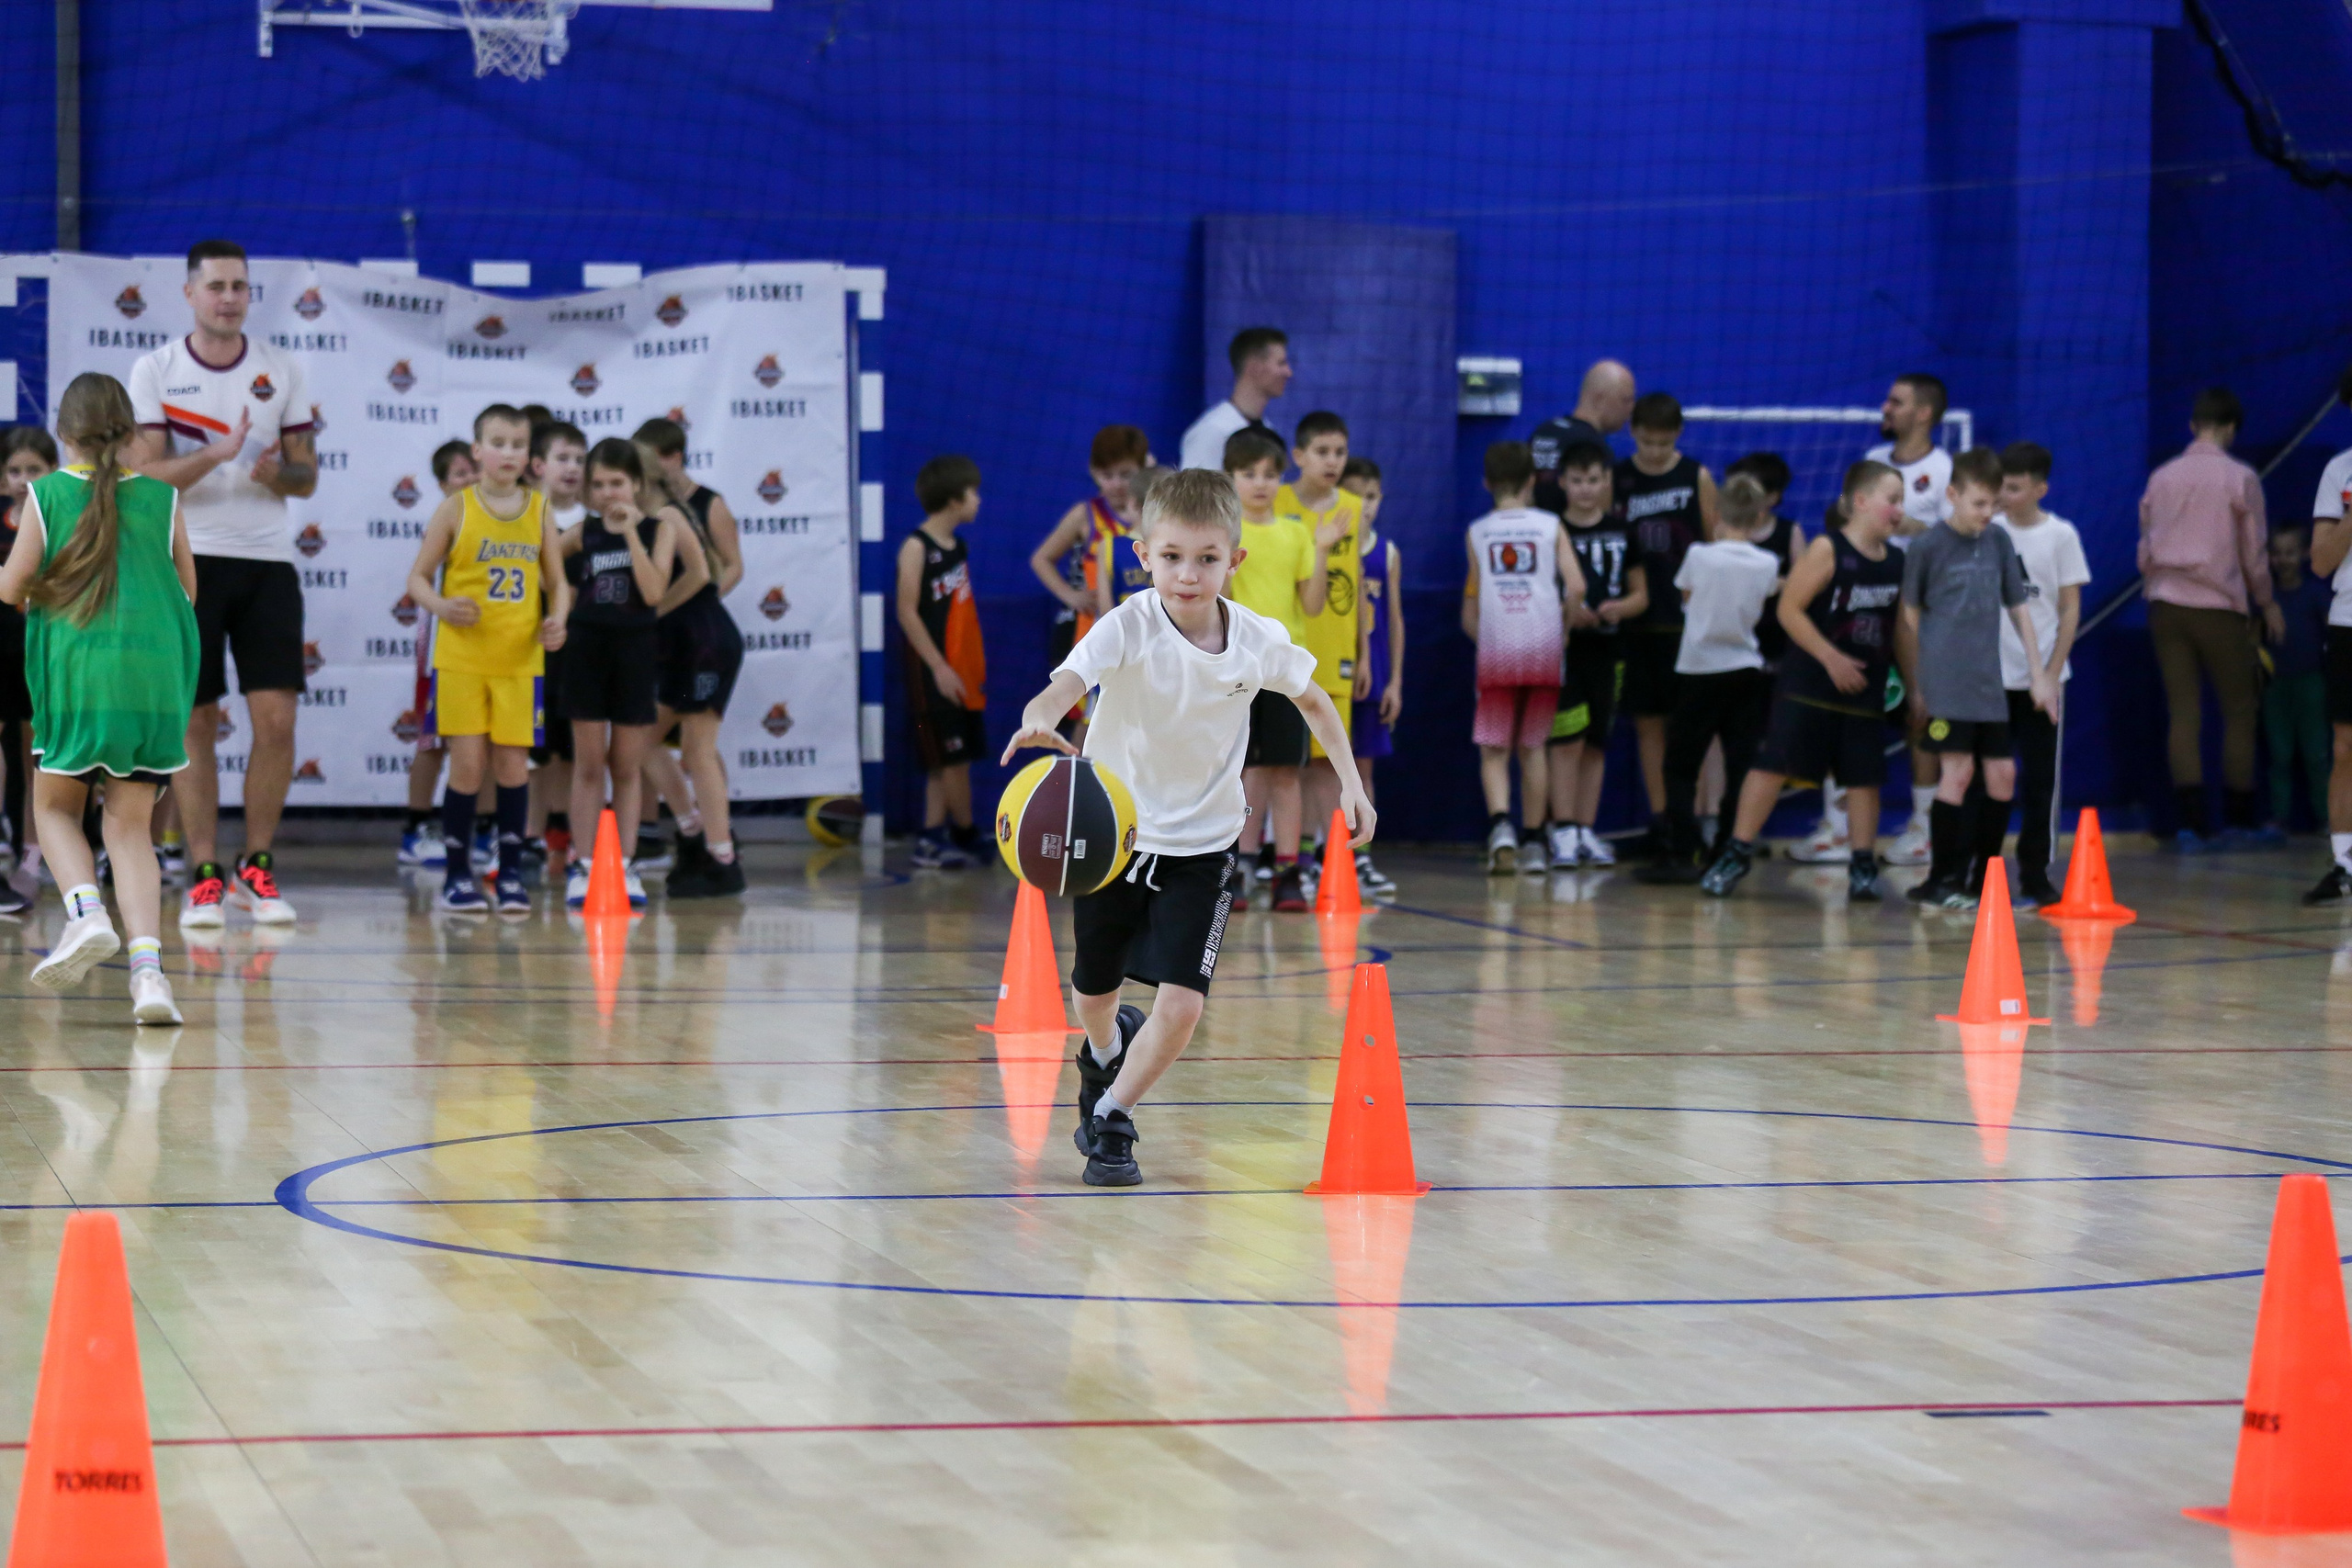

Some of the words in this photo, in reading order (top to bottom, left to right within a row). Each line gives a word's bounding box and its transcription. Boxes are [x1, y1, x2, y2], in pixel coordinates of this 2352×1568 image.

[552, 407, 623, 425] BASKET
[368, 521, 424, 539] IBASK
[740, 516, 809, 536] BASKET
[488, 567, 526, 603] 23
[366, 639, 412, 658] IBAS
[54, 1472, 141, 1494] TORRES
